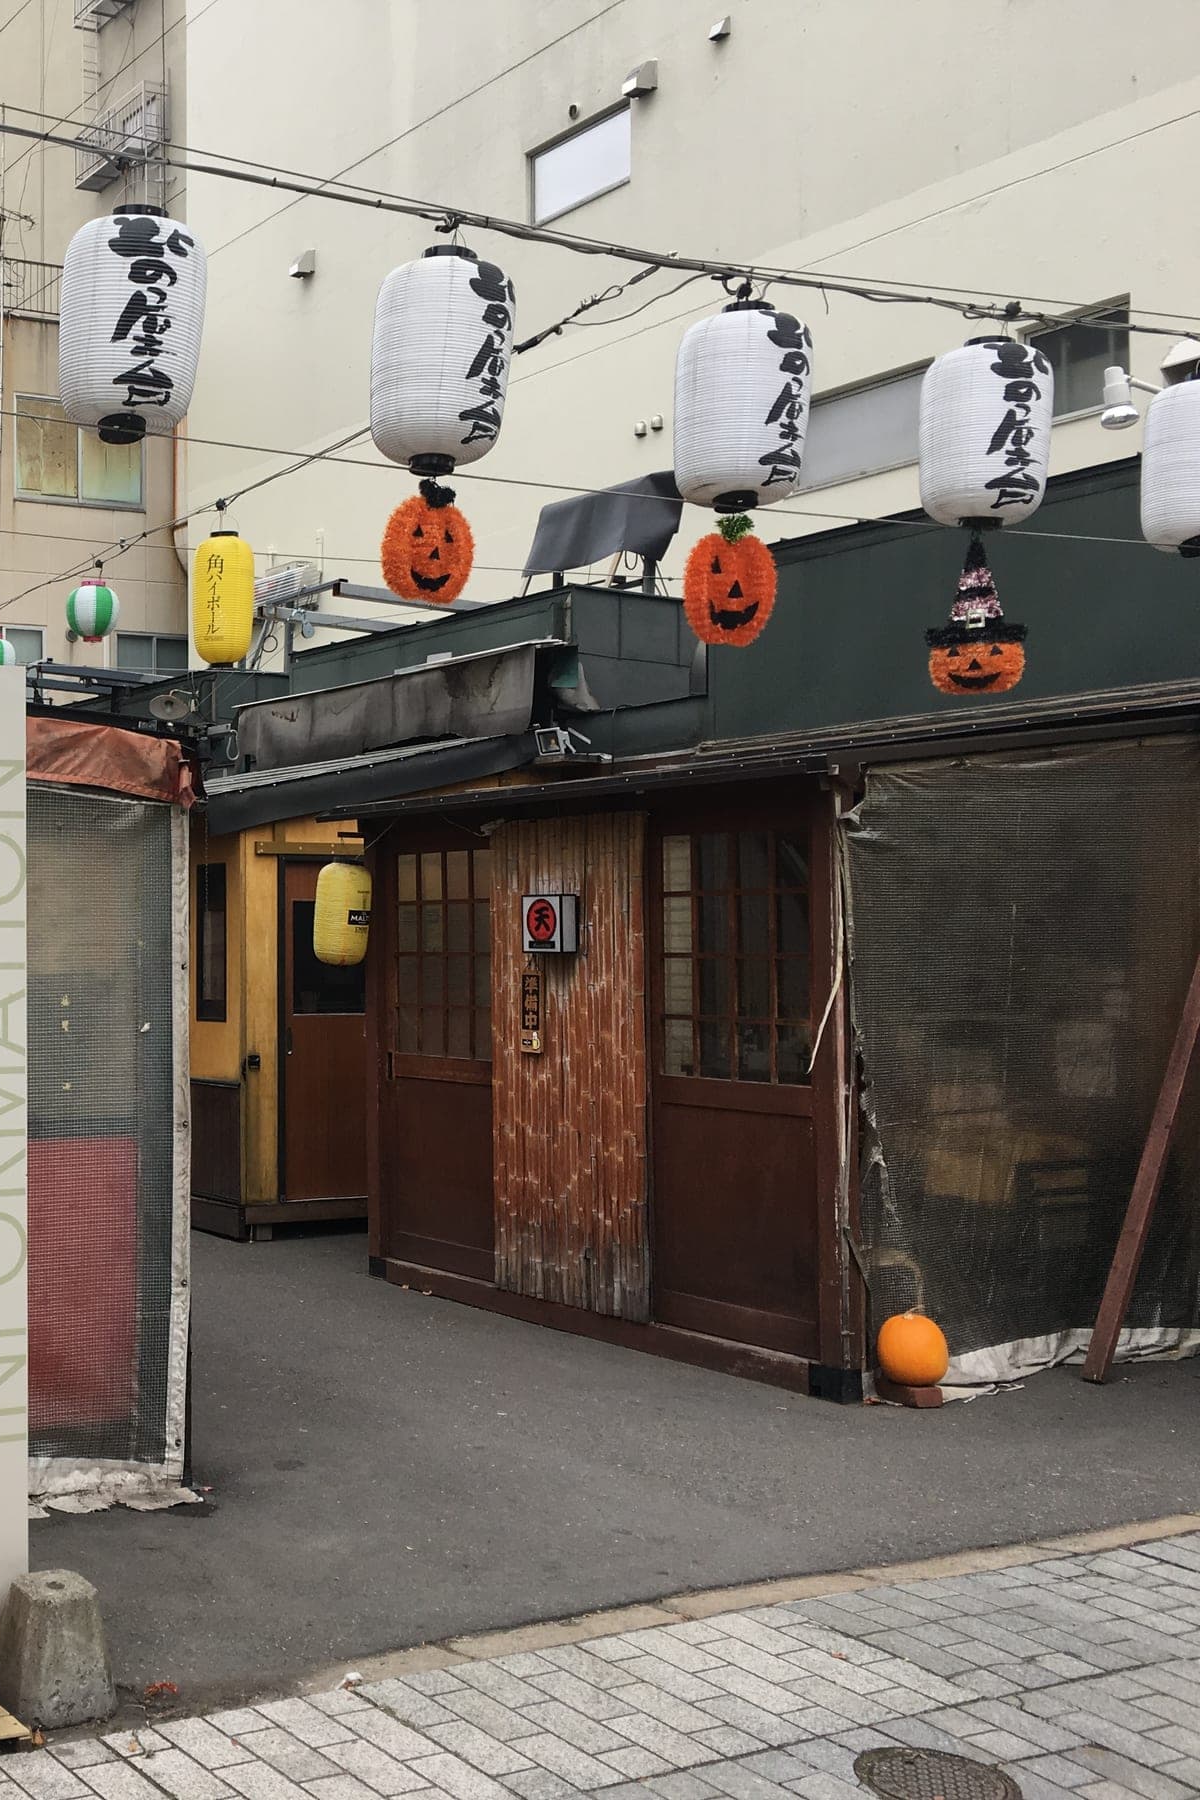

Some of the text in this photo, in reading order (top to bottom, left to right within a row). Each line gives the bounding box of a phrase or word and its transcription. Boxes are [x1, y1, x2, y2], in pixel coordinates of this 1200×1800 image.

[108, 216, 194, 407] 北の屋台
[983, 343, 1049, 509] 北の屋台
[206, 553, 224, 635] 角ハイボール
[534, 906, 551, 932] 天
[524, 976, 538, 1029] 準備中
